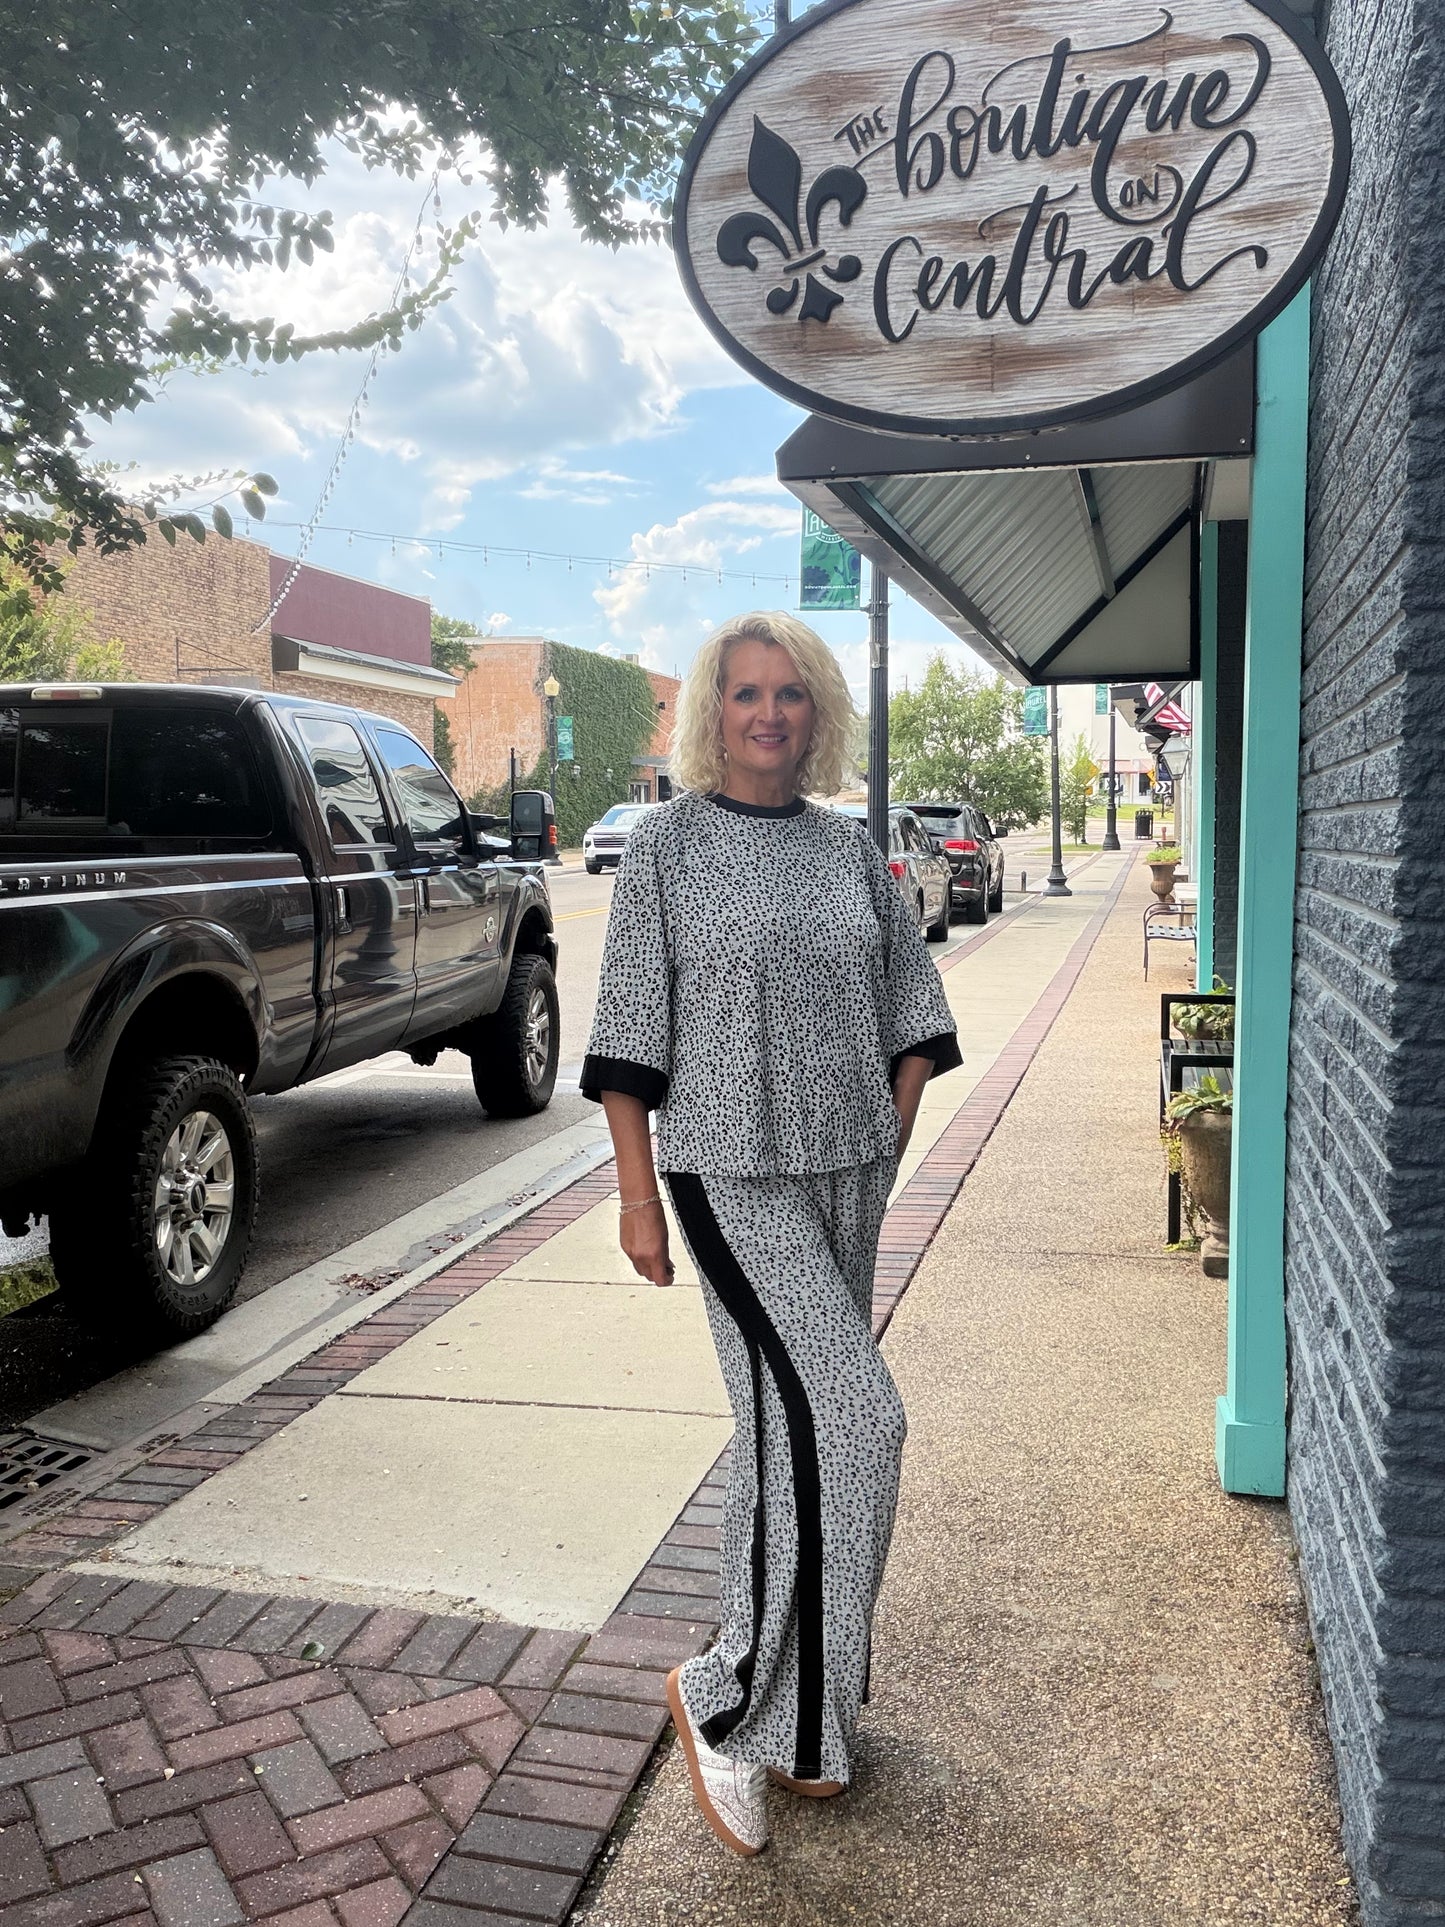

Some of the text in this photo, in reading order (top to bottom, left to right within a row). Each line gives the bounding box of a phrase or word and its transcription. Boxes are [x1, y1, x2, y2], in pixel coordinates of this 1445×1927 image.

[834, 9, 1271, 225] THE boutique
[1119, 165, 1162, 208] ON
[874, 128, 1268, 343] Central
